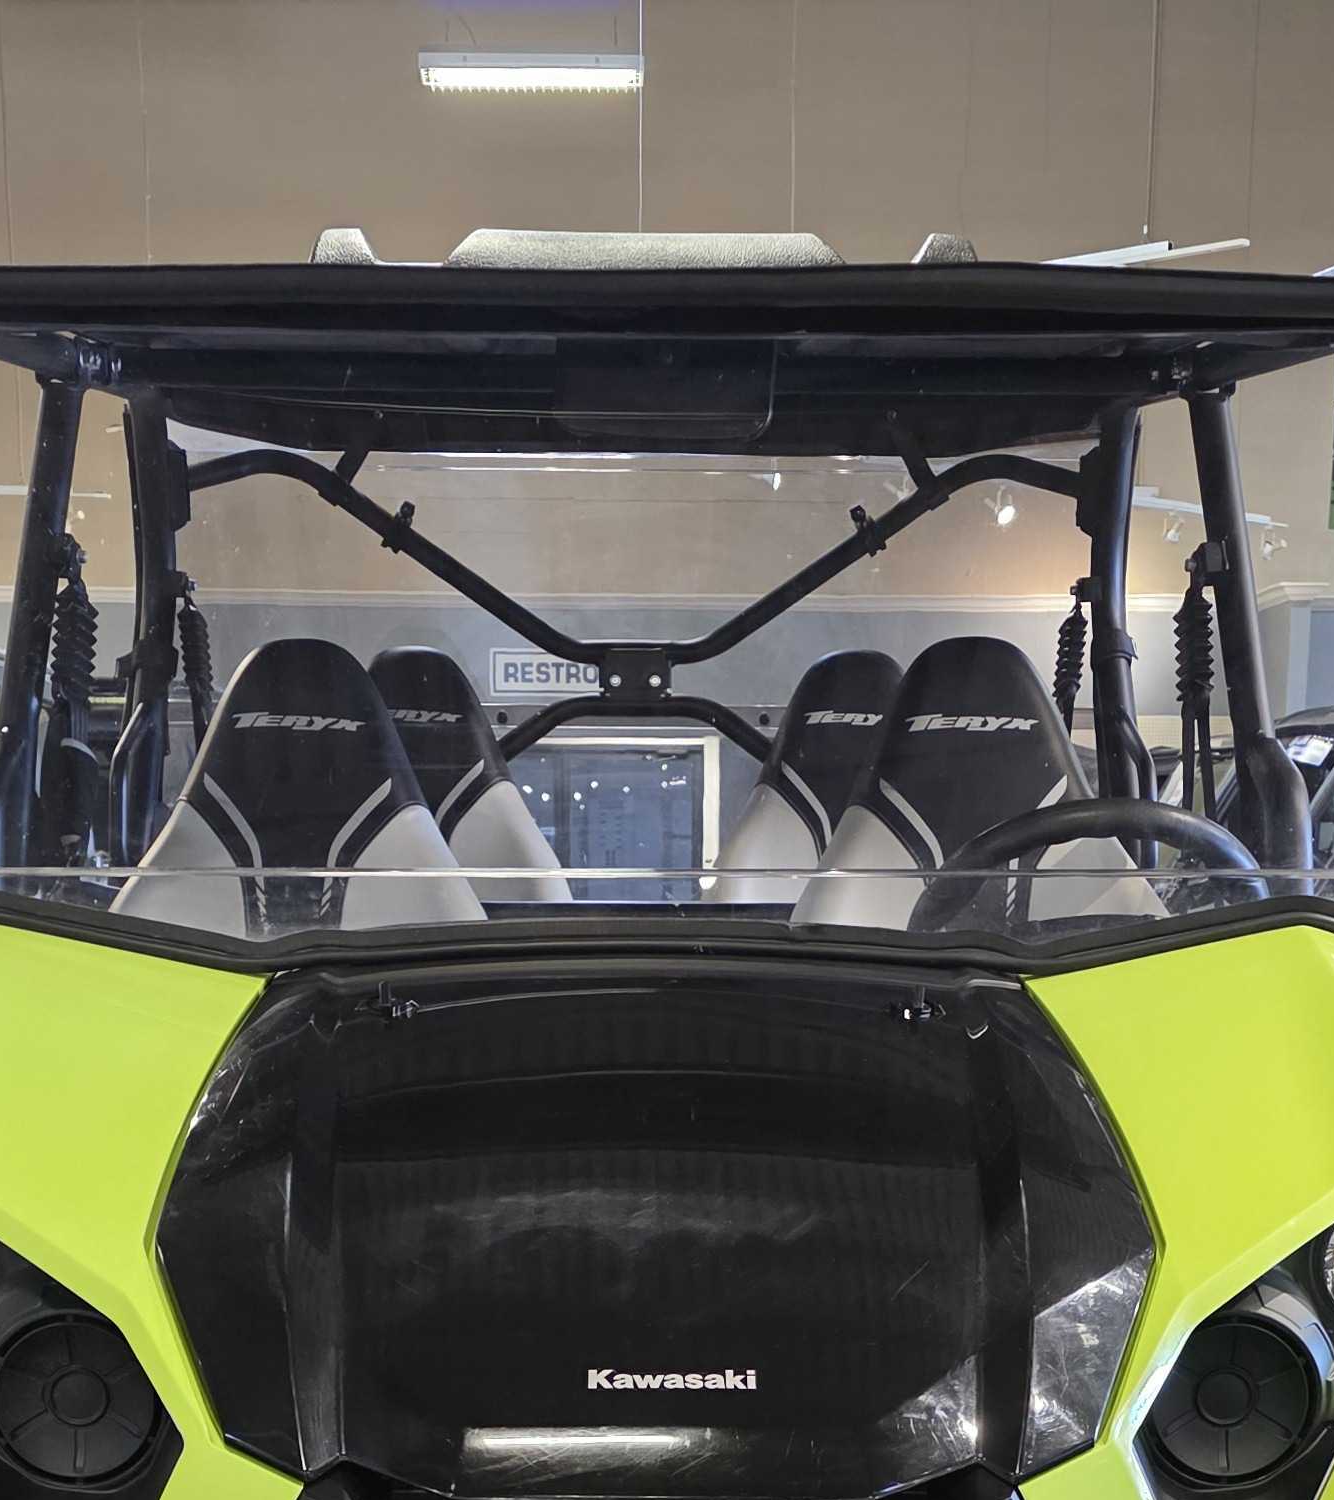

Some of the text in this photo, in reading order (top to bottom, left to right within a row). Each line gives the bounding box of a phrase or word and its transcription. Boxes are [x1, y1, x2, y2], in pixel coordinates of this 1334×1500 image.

[503, 662, 600, 684] RESTRO
[232, 711, 367, 732] TERYX
[386, 708, 464, 723] ERYX
[803, 710, 884, 726] TERY
[904, 713, 1040, 732] TERYX
[587, 1368, 758, 1391] Kawasaki
